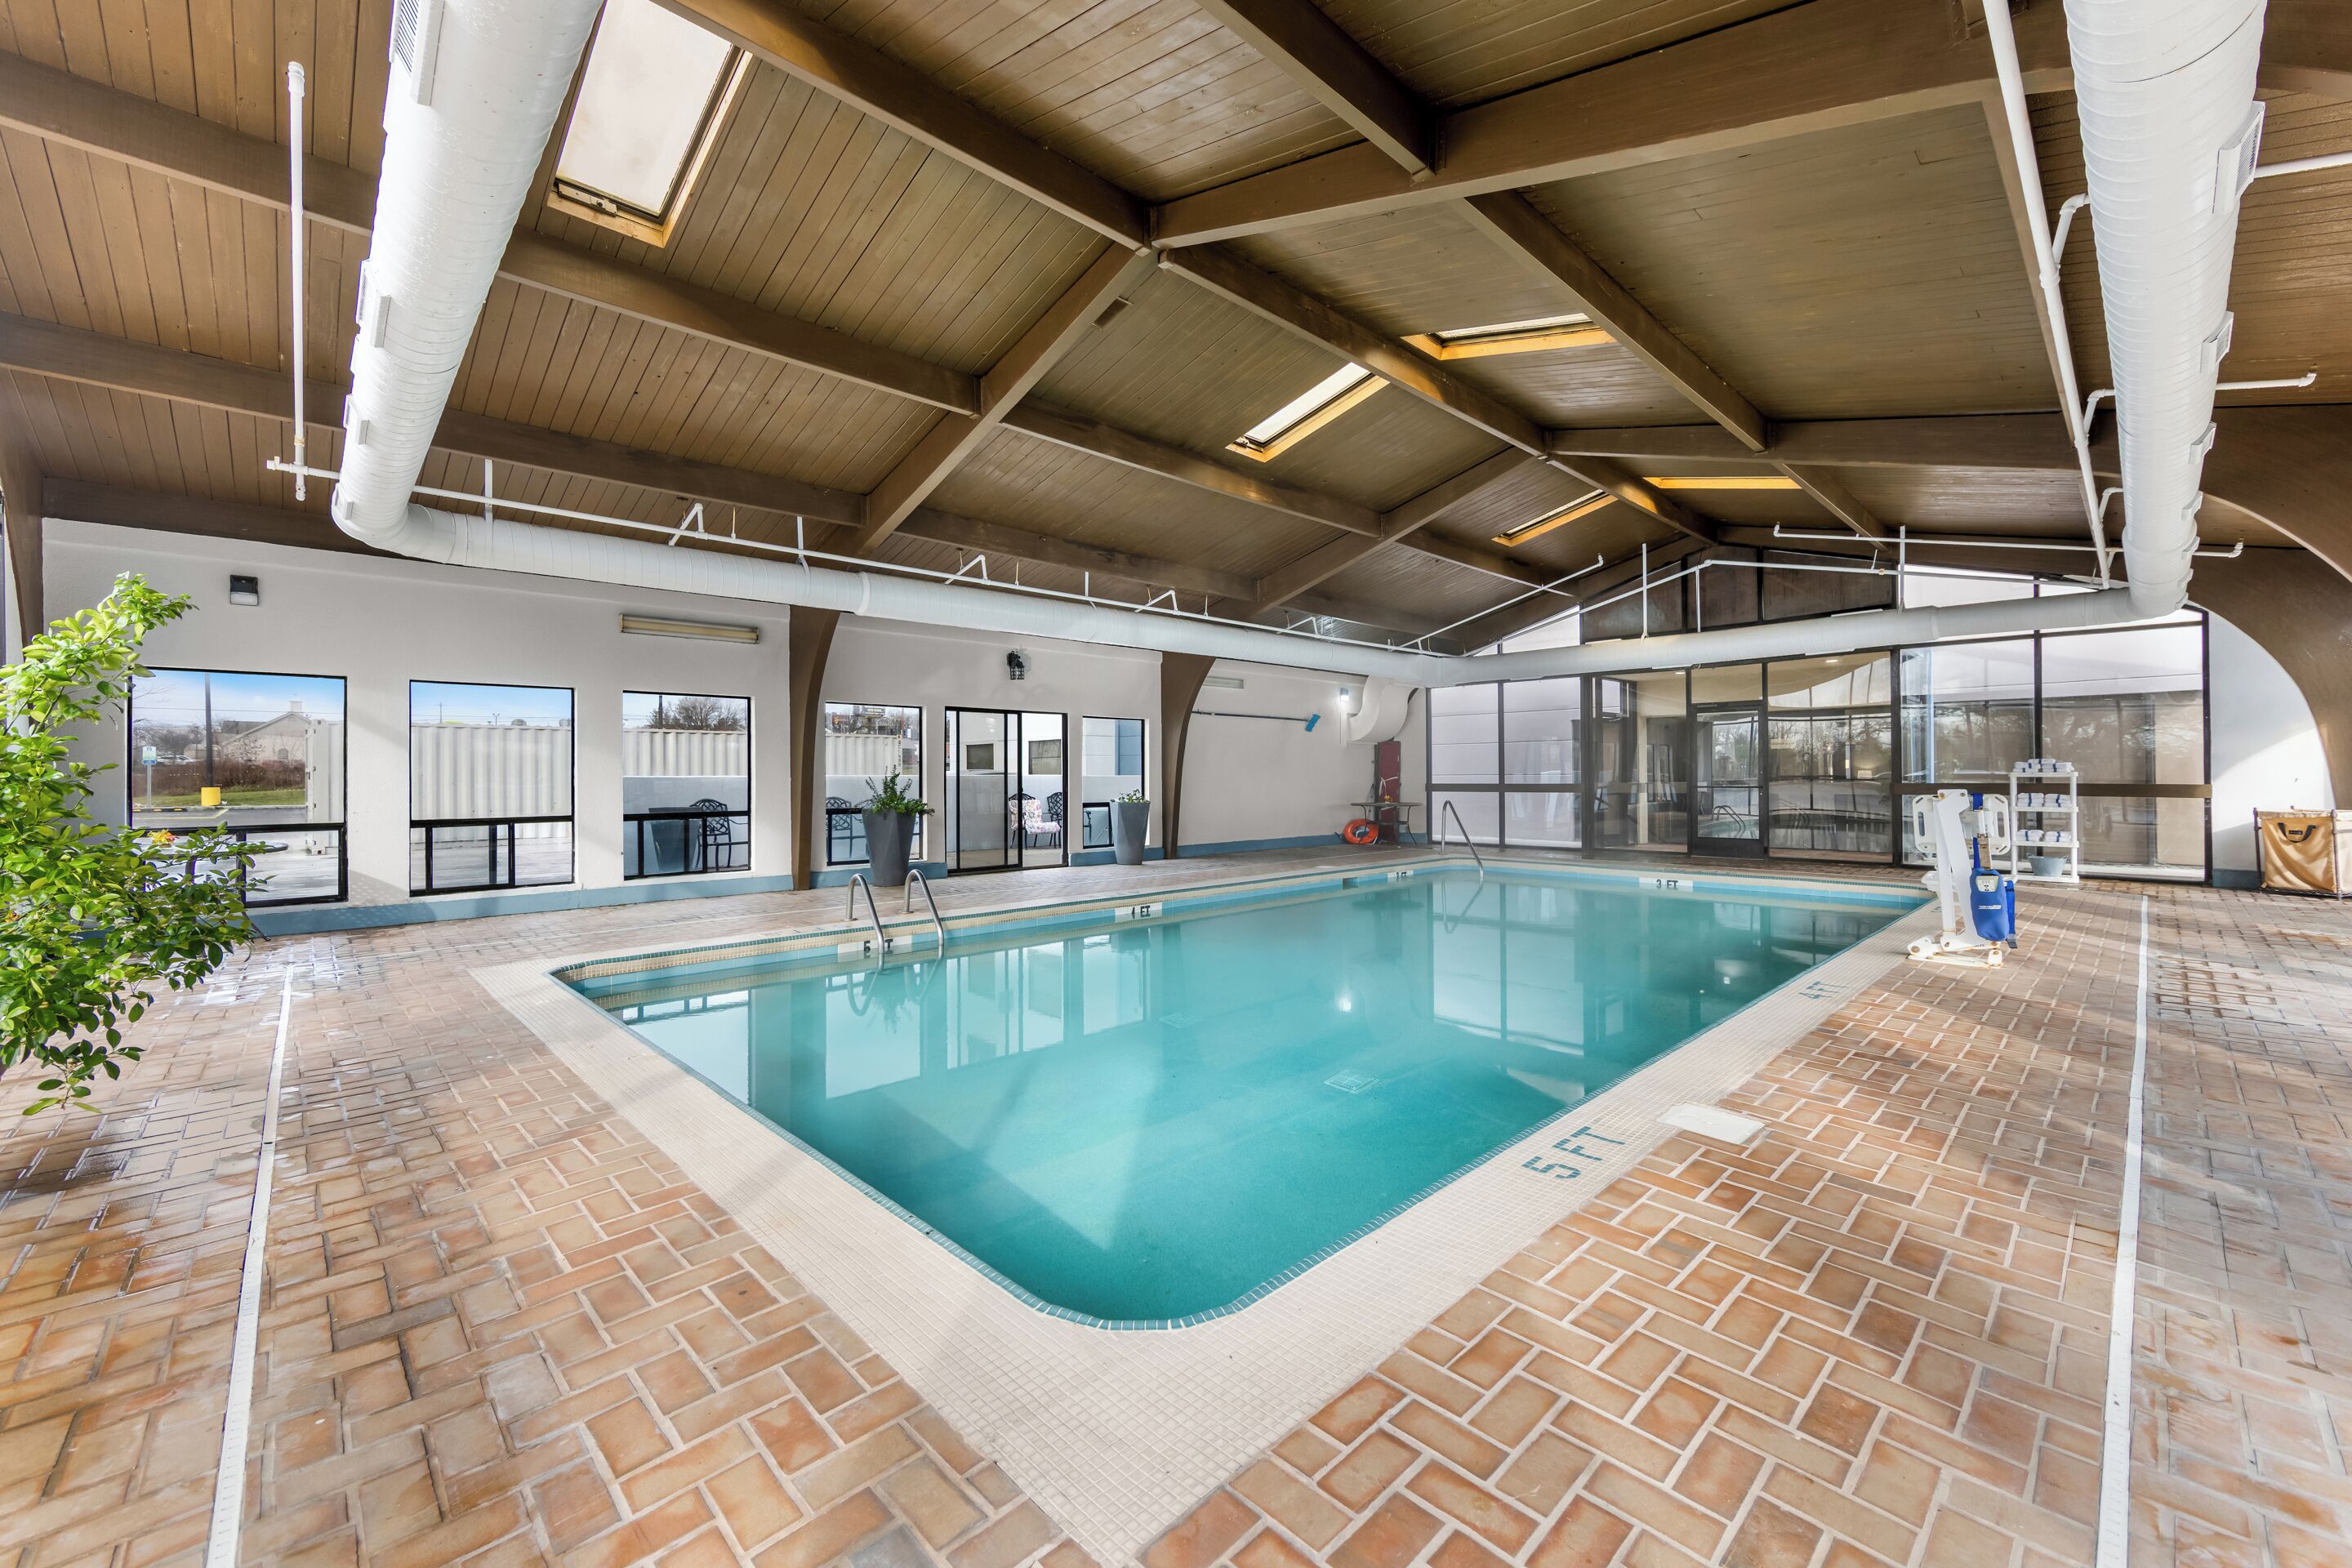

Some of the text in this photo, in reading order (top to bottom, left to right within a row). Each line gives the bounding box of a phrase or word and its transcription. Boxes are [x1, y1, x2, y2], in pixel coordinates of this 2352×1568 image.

[1656, 879, 1679, 889] 3 FT
[1552, 1125, 1626, 1161] FT
